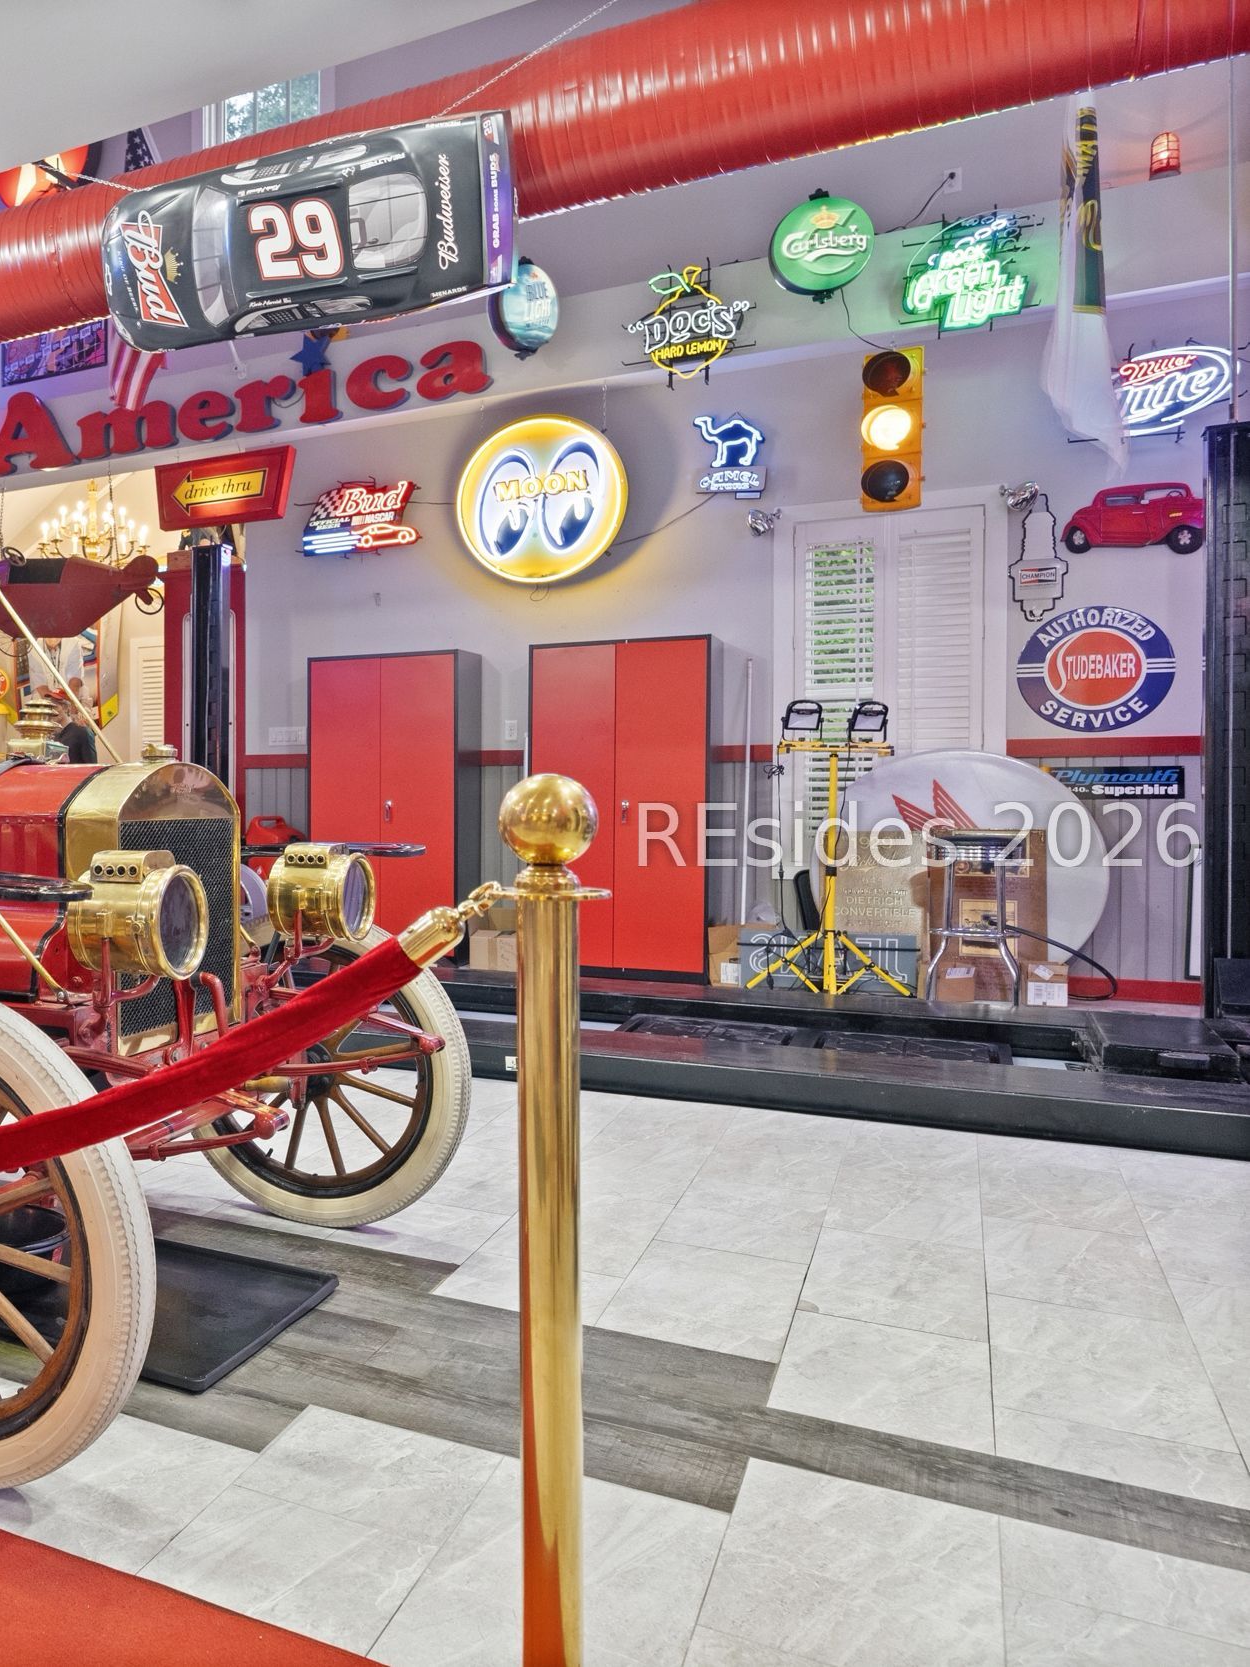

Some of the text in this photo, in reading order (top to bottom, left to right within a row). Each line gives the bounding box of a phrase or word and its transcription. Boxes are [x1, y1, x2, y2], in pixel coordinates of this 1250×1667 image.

[483, 118, 493, 136] 29
[490, 152, 500, 188] BUDS
[436, 153, 459, 271] Budweiser
[248, 198, 344, 281] 29
[489, 213, 500, 249] GRAB
[782, 229, 868, 259] Carlsberg
[123, 210, 182, 322] Bud
[431, 286, 468, 298] MENARDS
[526, 282, 548, 301] BLUE
[907, 260, 1001, 313] Green
[945, 274, 1026, 327] Light
[655, 340, 722, 360] HARD LEMON
[1119, 355, 1197, 382] Miller
[184, 479, 252, 500] drive thru
[494, 470, 589, 501] MOON
[700, 471, 759, 487] CAMEL
[336, 480, 408, 516] Bud
[309, 517, 350, 527] OFFICIAL
[316, 523, 341, 531] BEER
[364, 511, 395, 524] NASCAR
[1021, 571, 1056, 580] CHAMPION
[1036, 607, 1156, 648] AUTHORIZED
[1056, 643, 1136, 692] STUDEBAKER
[1040, 696, 1149, 729] SERVICE
[1053, 769, 1180, 784] Plymouth
[1091, 784, 1178, 796] Superbird
[834, 907, 918, 917] CONVERTIBLE
[846, 896, 903, 906] DIETRICH
